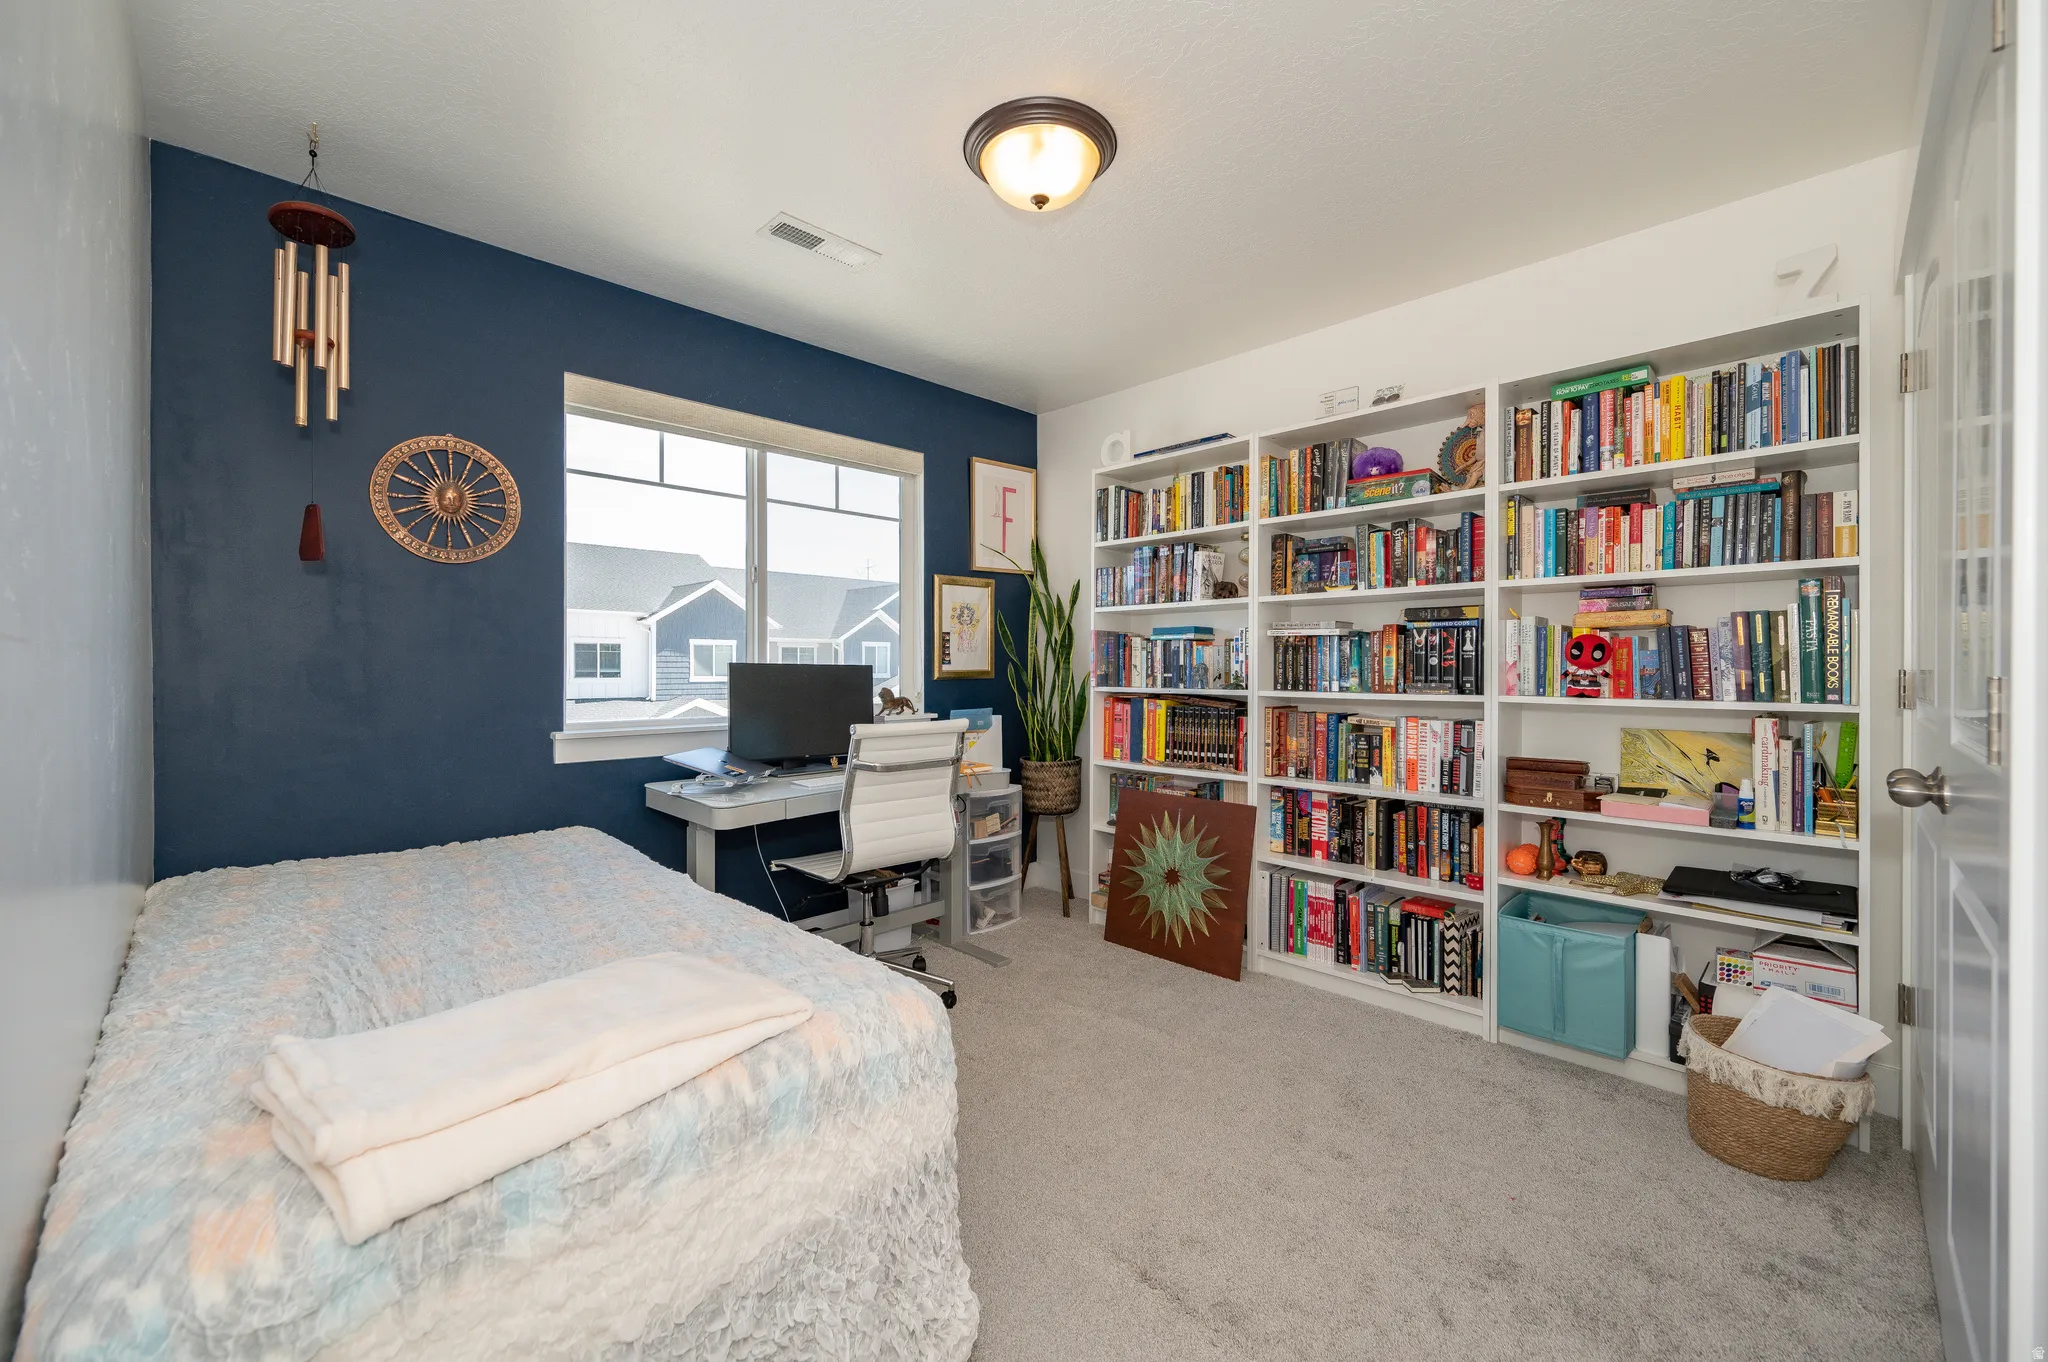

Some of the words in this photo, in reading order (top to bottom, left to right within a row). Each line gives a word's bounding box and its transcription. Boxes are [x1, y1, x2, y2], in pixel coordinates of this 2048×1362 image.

[1751, 383, 1759, 401] GOAL
[1364, 486, 1391, 498] scene
[1392, 482, 1404, 494] it?
[1842, 510, 1852, 523] RAND
[1843, 500, 1852, 510] AYN
[1002, 487, 1016, 553] F
[1358, 526, 1366, 548] ROGUES
[1805, 620, 1818, 652] PASTA
[1826, 594, 1839, 654] REMARKABLE
[1384, 656, 1394, 685] DUNE
[1826, 656, 1839, 689] BOOKS
[1407, 721, 1417, 760] AIRFRAME
[1419, 722, 1427, 750] MICHAEL
[1419, 754, 1427, 785] CRICHTON
[1452, 759, 1460, 784] CRICHTON
[1758, 736, 1772, 787] cardmaking
[1311, 812, 1327, 841] KING
[1330, 807, 1338, 827] KING
[1431, 810, 1439, 828] DALE
[1431, 829, 1439, 856] BROWN
[1759, 961, 1798, 972] PRIORITY
[1768, 968, 1789, 976] MAIL
